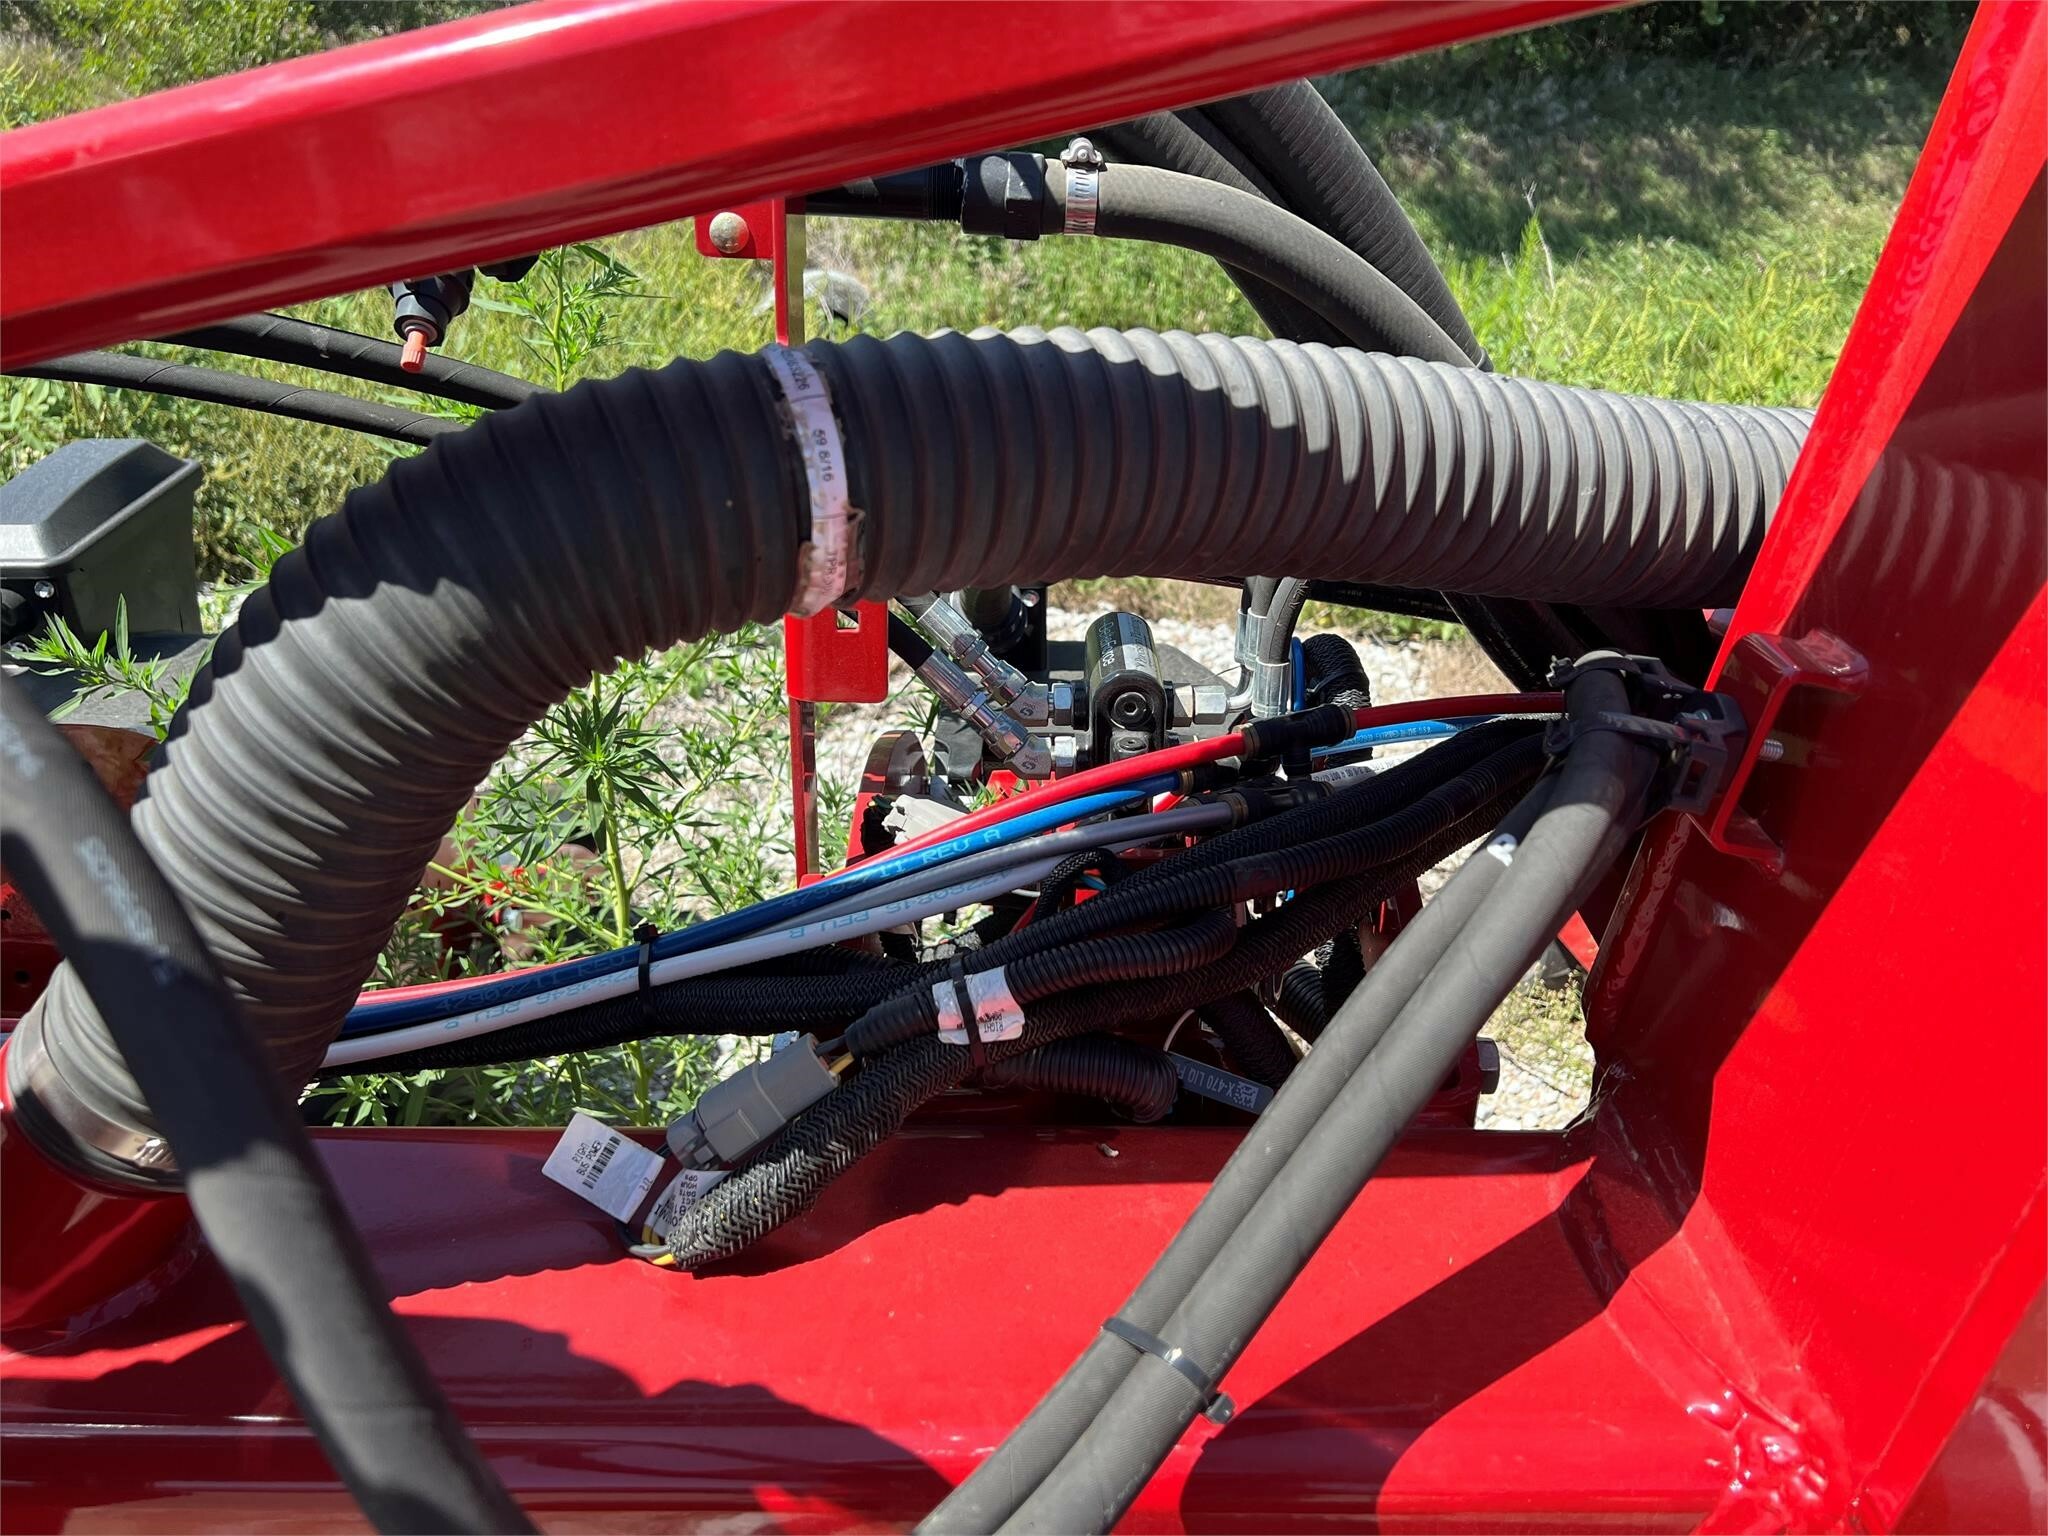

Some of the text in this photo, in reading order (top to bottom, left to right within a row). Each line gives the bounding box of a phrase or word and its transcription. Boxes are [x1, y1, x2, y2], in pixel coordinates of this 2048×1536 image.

[921, 838, 972, 865] REV
[983, 829, 1002, 844] A
[1188, 1066, 1206, 1088] LIQ
[1206, 1075, 1236, 1098] X-470
[576, 1161, 591, 1176] BUS
